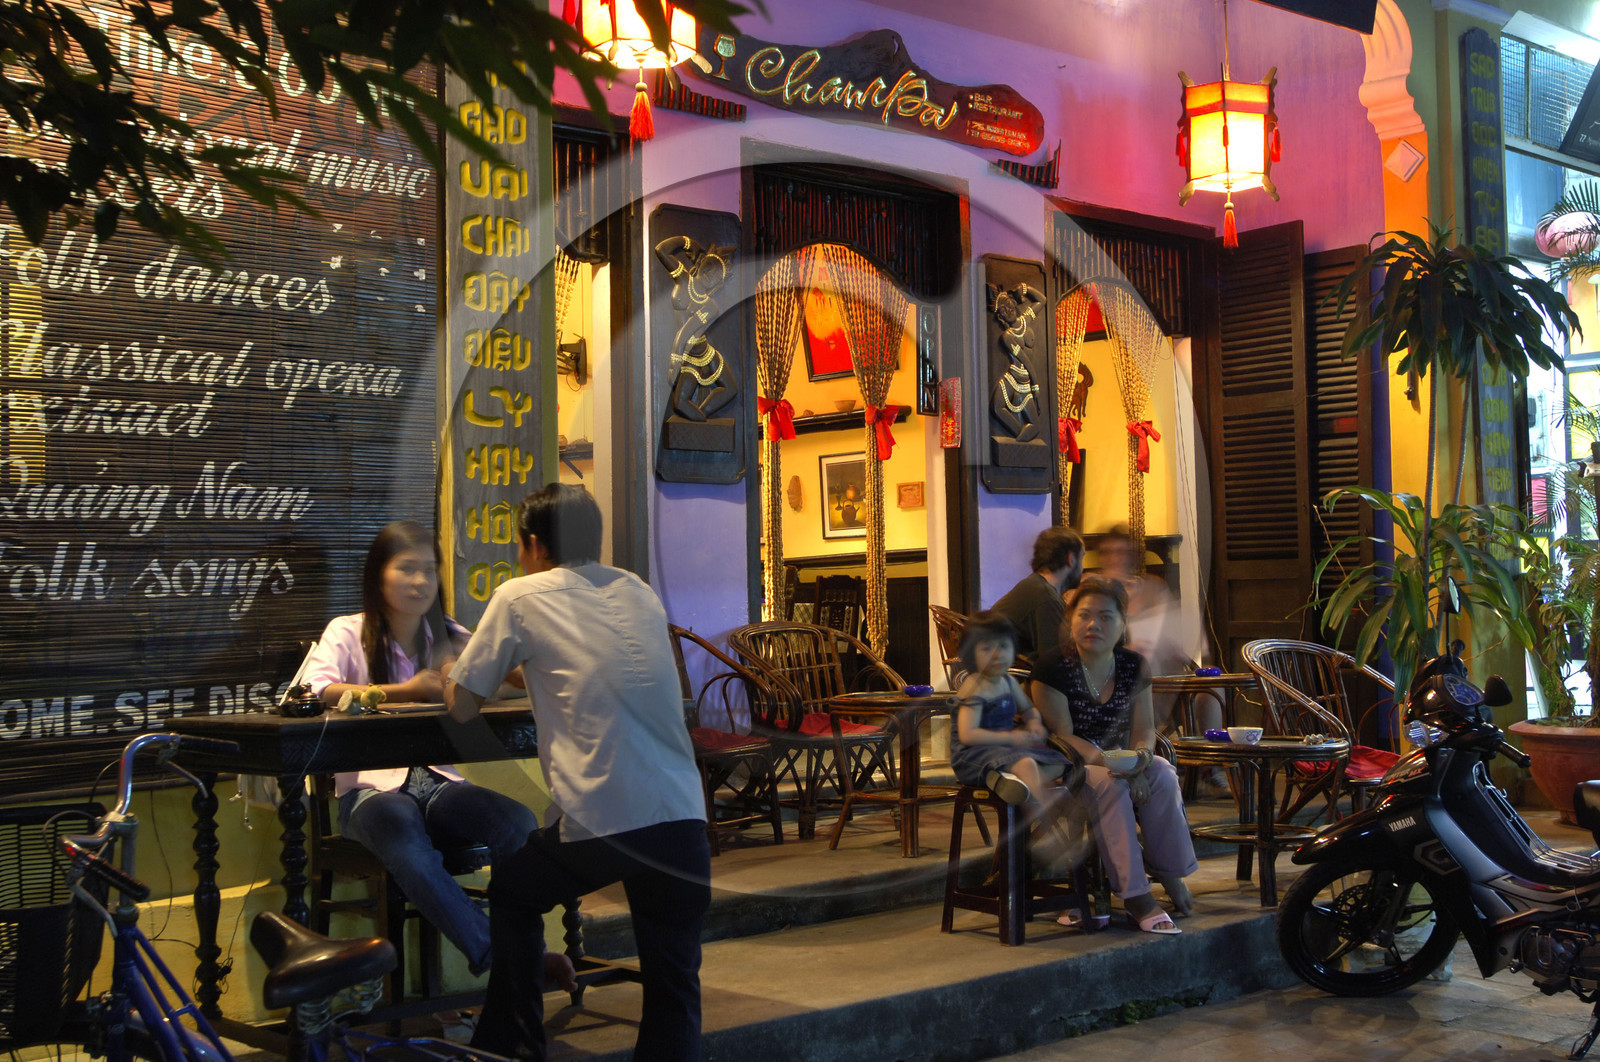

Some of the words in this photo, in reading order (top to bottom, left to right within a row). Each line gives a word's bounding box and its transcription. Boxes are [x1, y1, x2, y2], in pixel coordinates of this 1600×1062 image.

[307, 151, 430, 199] music
[134, 244, 335, 315] dances
[265, 357, 402, 410] opera
[176, 460, 314, 522] Nam
[130, 557, 295, 622] songs
[1389, 816, 1416, 832] YAMAHA
